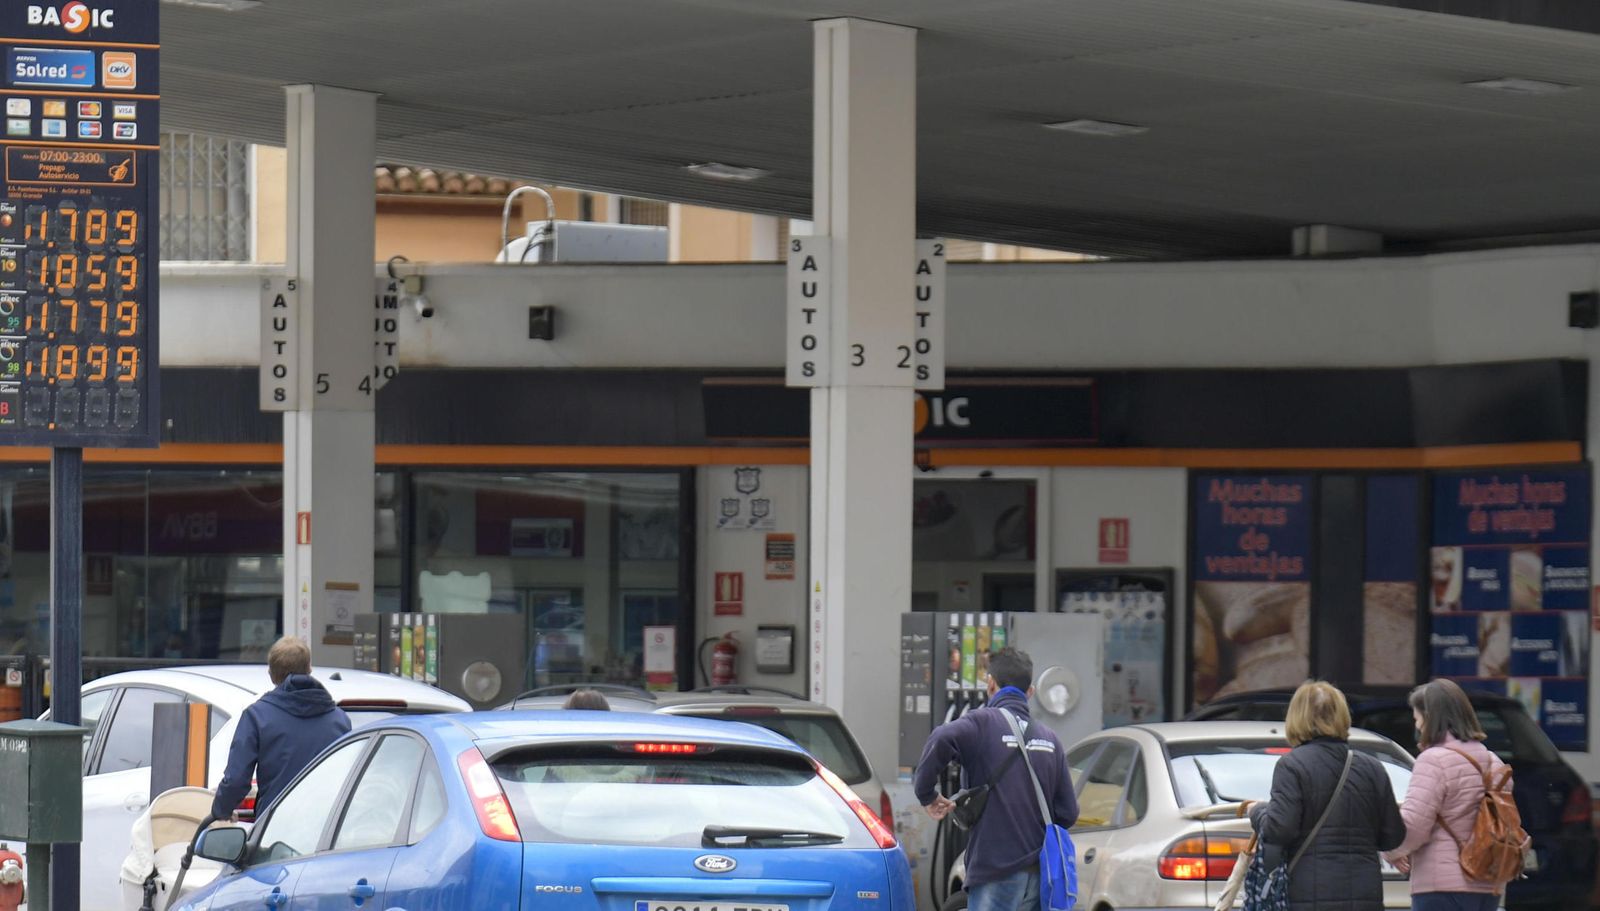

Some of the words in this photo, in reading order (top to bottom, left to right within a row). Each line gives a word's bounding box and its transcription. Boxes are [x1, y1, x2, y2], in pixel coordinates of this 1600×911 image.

[27, 4, 114, 29] BASIC
[16, 62, 67, 79] Solred
[109, 65, 130, 74] DKV
[38, 163, 66, 173] Prepago
[38, 172, 80, 180] Autoservicio
[25, 208, 137, 248] 1.789
[792, 239, 802, 252] 3
[933, 243, 943, 256] 2
[40, 253, 138, 294] 1.859
[287, 280, 296, 291] 5
[387, 282, 397, 292] 4
[8, 317, 20, 326] 95
[25, 299, 138, 339] 1.779
[801, 255, 817, 378] AUTOS
[915, 259, 932, 380] AUTOS
[273, 293, 287, 402] AUTOS
[851, 344, 865, 367] 3
[896, 345, 911, 368] 2
[8, 362, 20, 372] 98
[25, 344, 138, 384] 1.899
[316, 373, 330, 394] 5
[358, 375, 372, 395] 4
[0, 402, 9, 415] B
[1208, 479, 1302, 501] Muchas
[1459, 476, 1519, 505] Muchas
[1522, 475, 1566, 504] horas
[1222, 500, 1287, 525] horas
[1468, 503, 1488, 532] de
[1491, 502, 1556, 538] ventajas
[1238, 526, 1270, 551] de
[1205, 551, 1303, 581] ventajas
[535, 884, 583, 893] FOCUS
